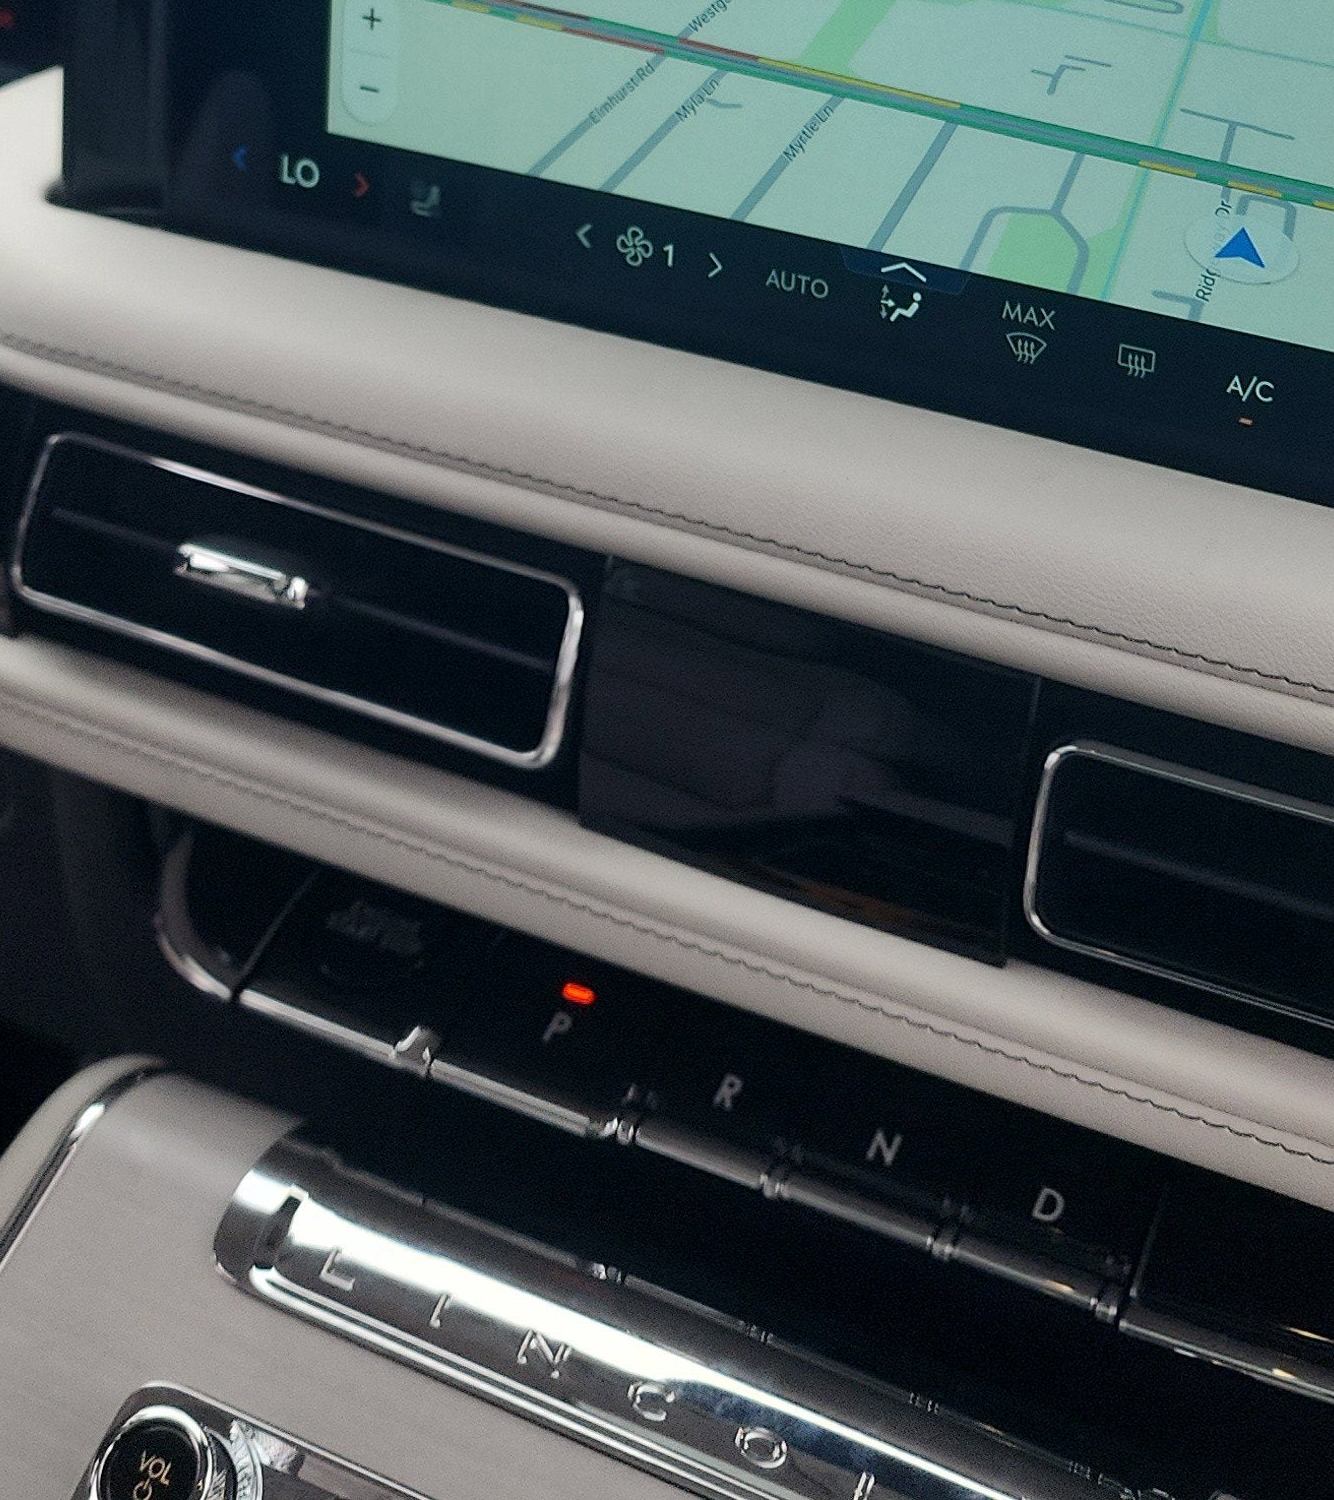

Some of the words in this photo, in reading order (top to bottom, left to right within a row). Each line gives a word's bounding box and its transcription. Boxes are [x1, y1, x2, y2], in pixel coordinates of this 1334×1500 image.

[588, 80, 639, 125] Elmhurst
[635, 61, 655, 84] Rd
[675, 92, 707, 123] Myla
[703, 77, 721, 98] Ln
[782, 119, 820, 163] Myrtle
[817, 104, 835, 124] Ln
[279, 154, 321, 189] LO
[1214, 200, 1233, 219] Dr
[663, 243, 675, 268] 1
[766, 268, 830, 299] AUTO
[1002, 301, 1057, 331] MAX
[1226, 375, 1275, 406] A/C
[542, 1011, 574, 1043] P
[712, 1073, 744, 1112] R
[867, 1128, 903, 1167] N
[1031, 1186, 1065, 1222] D
[139, 1449, 172, 1487] VOL
